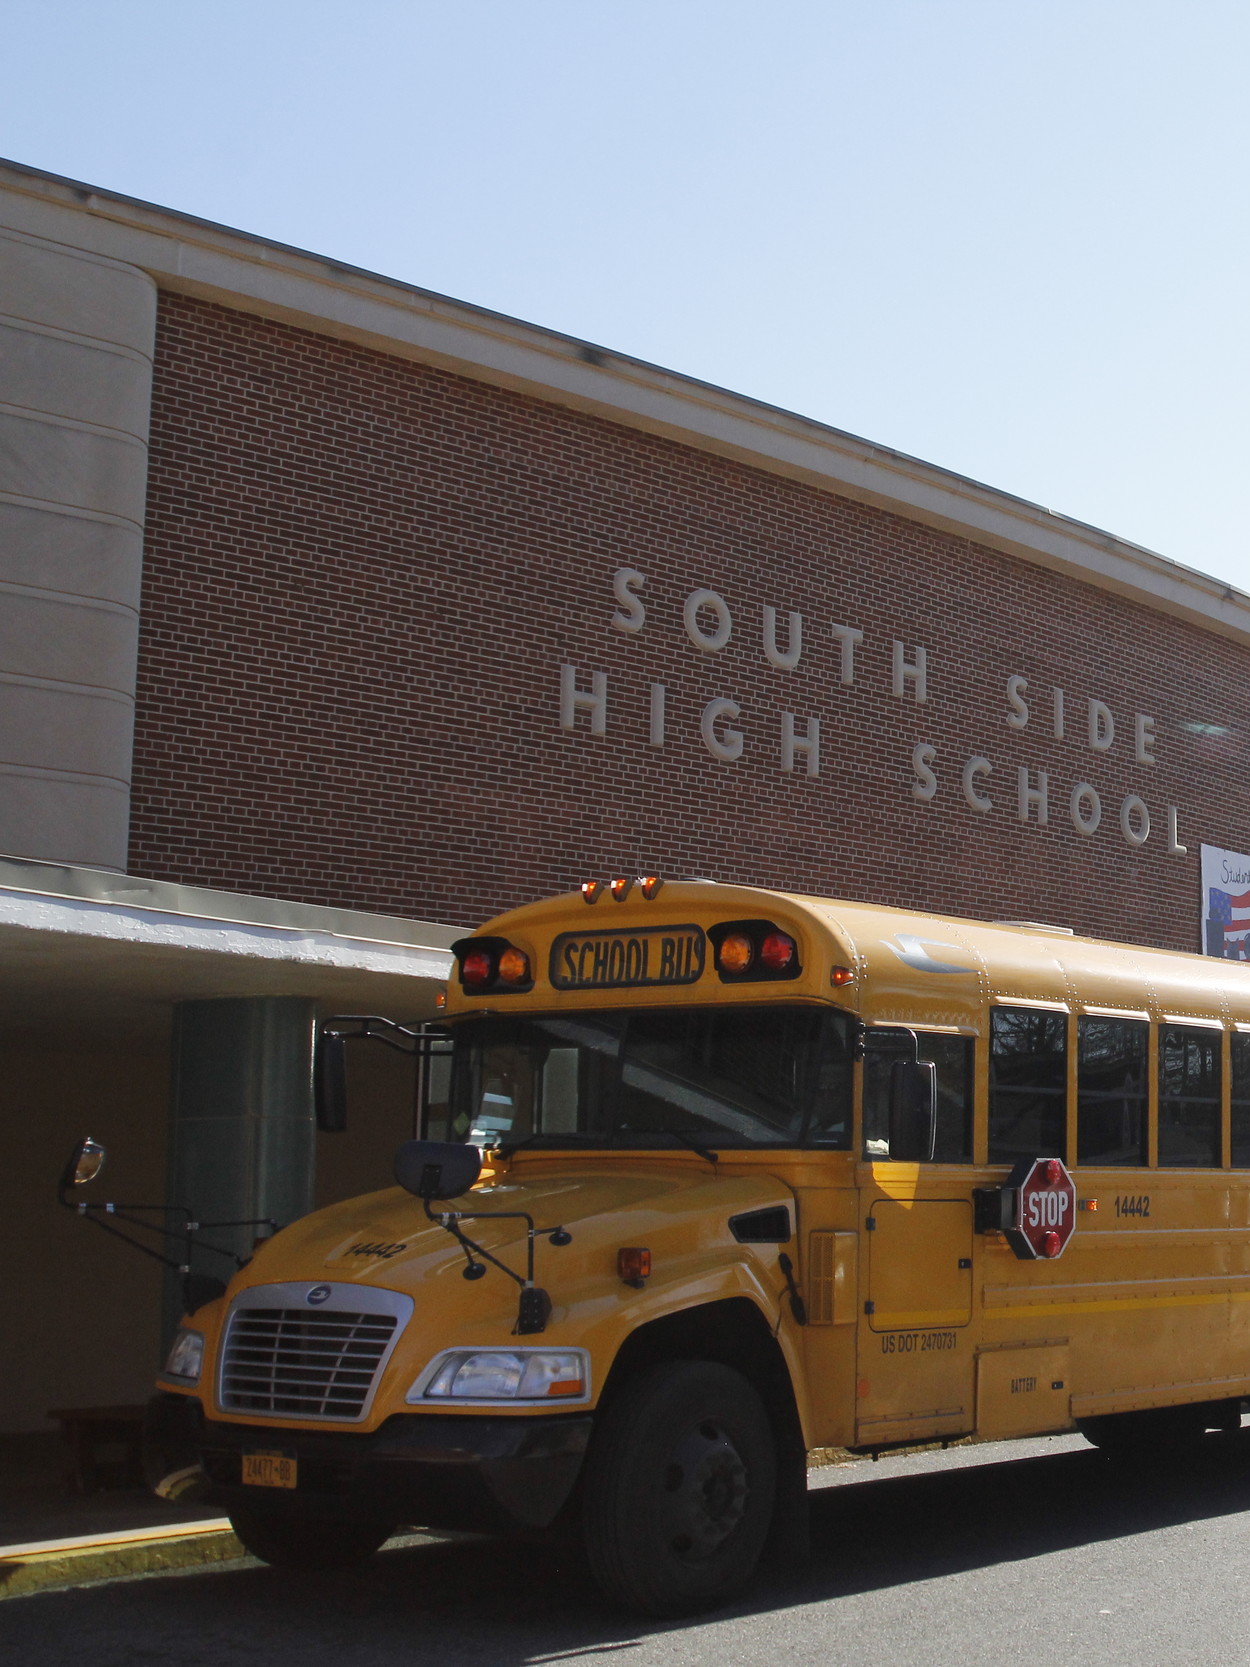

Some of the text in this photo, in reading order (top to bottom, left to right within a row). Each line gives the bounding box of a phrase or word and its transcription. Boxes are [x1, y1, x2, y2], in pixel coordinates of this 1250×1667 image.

[611, 567, 1155, 765] SOUTH SIDE
[560, 663, 1188, 855] HIGH SCHOOL
[562, 936, 703, 984] SCHOOL BUS
[1028, 1191, 1068, 1227] STOP
[1114, 1195, 1150, 1218] 14442
[343, 1242, 407, 1258] 14442
[881, 1332, 957, 1354] US DOT 2470731
[1011, 1377, 1038, 1394] BATTERY
